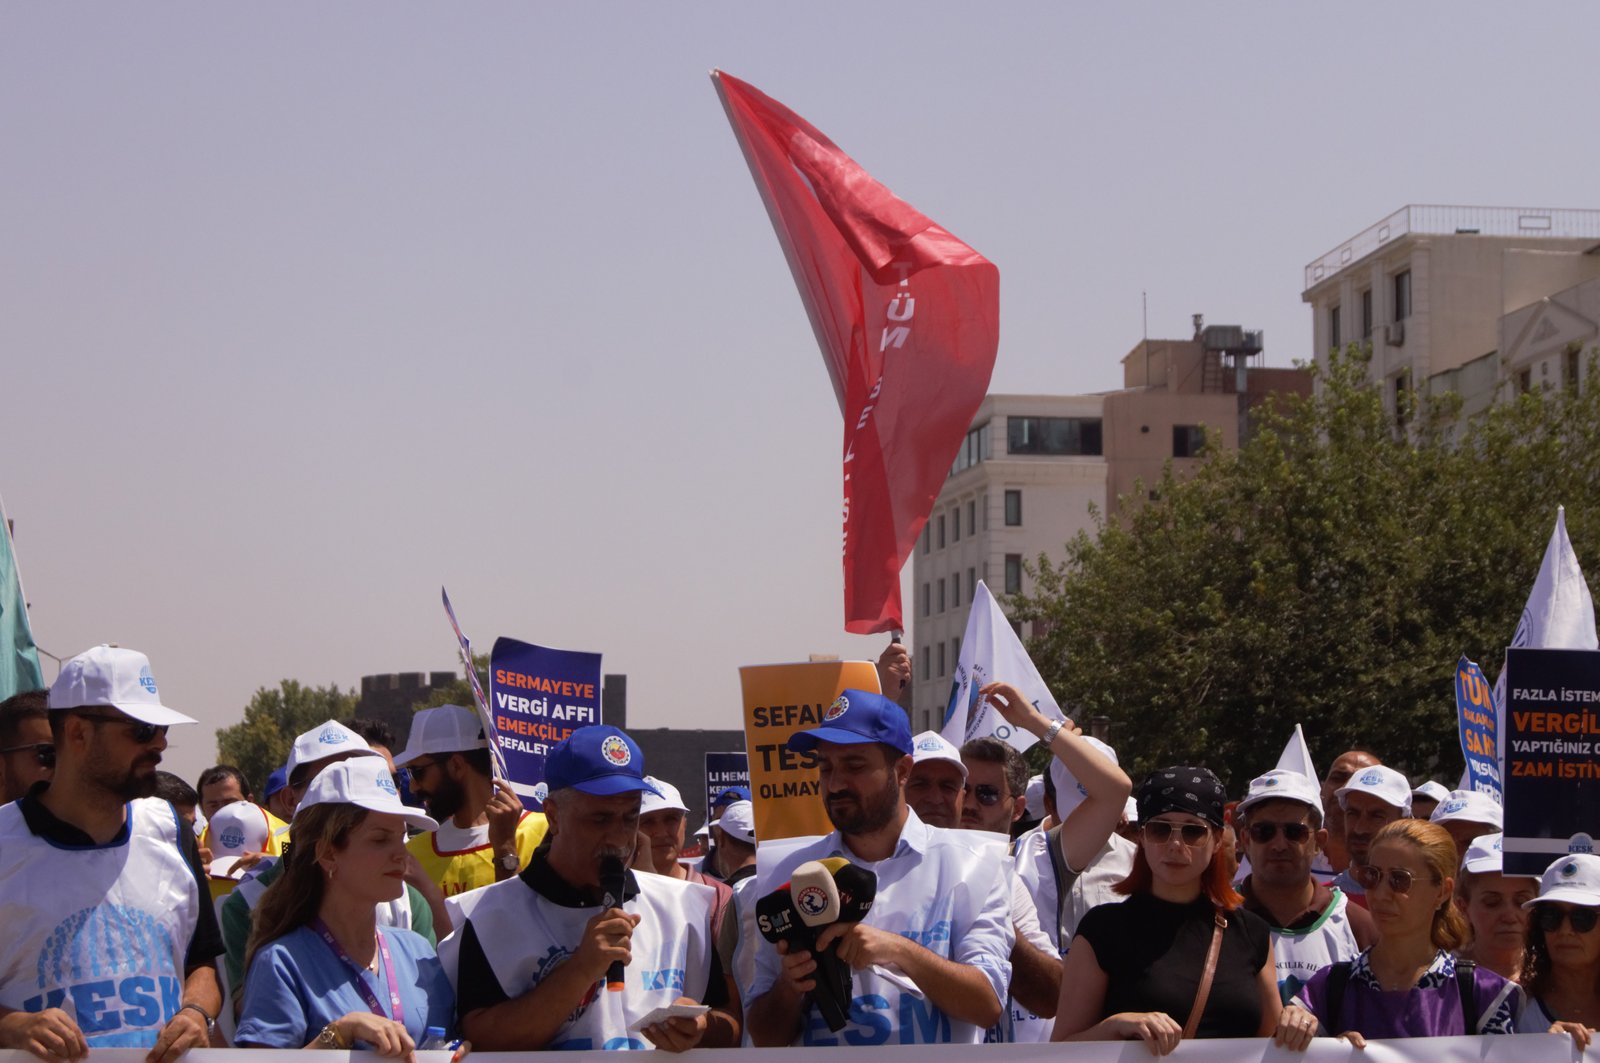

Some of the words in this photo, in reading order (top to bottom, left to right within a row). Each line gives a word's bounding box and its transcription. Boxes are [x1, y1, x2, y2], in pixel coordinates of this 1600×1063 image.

[496, 669, 594, 698] SERMAYEYE
[1513, 689, 1557, 701] FAZLA
[496, 692, 547, 716] VERGİ
[551, 706, 594, 723] AFFI
[497, 716, 575, 741] EMEKÇİLE
[1513, 709, 1600, 734] VERGİL
[1512, 739, 1591, 755] YAPTIĞINIZ
[709, 772, 719, 782] LI
[1512, 761, 1552, 778] ZAM
[220, 834, 245, 845] KESK
[1568, 844, 1592, 852] KESK
